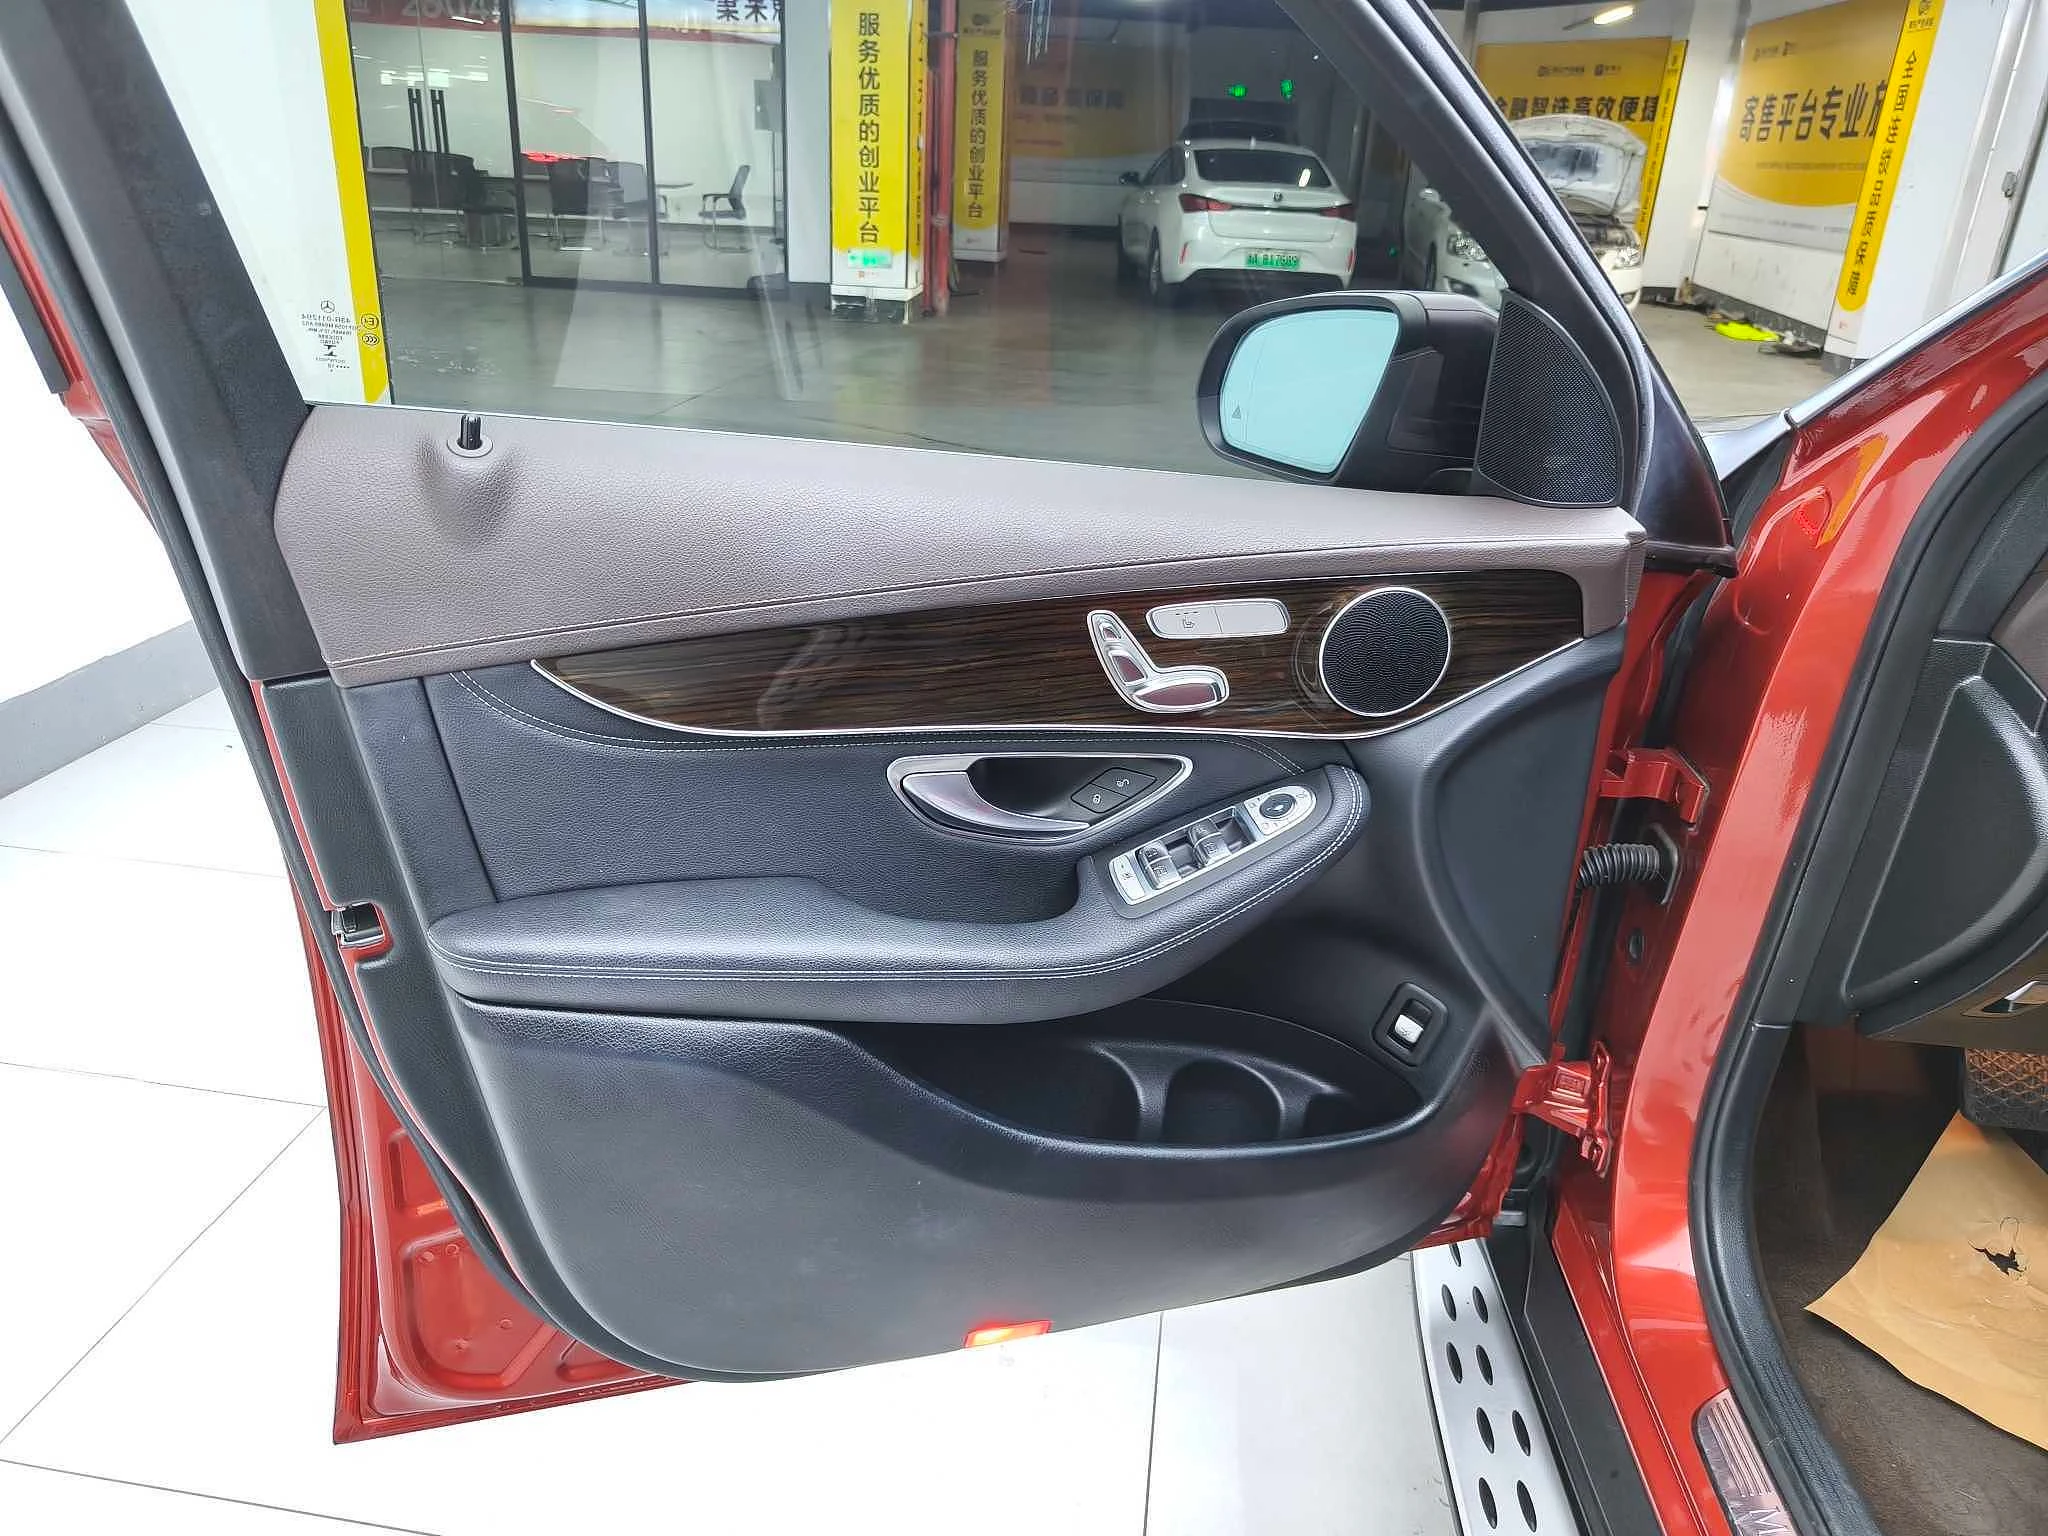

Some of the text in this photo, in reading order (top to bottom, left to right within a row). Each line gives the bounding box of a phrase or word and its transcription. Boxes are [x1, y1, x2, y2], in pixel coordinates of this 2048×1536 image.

[858, 12, 880, 243] 服务优质的创业平台
[967, 49, 989, 218] 服务优质的创业平台
